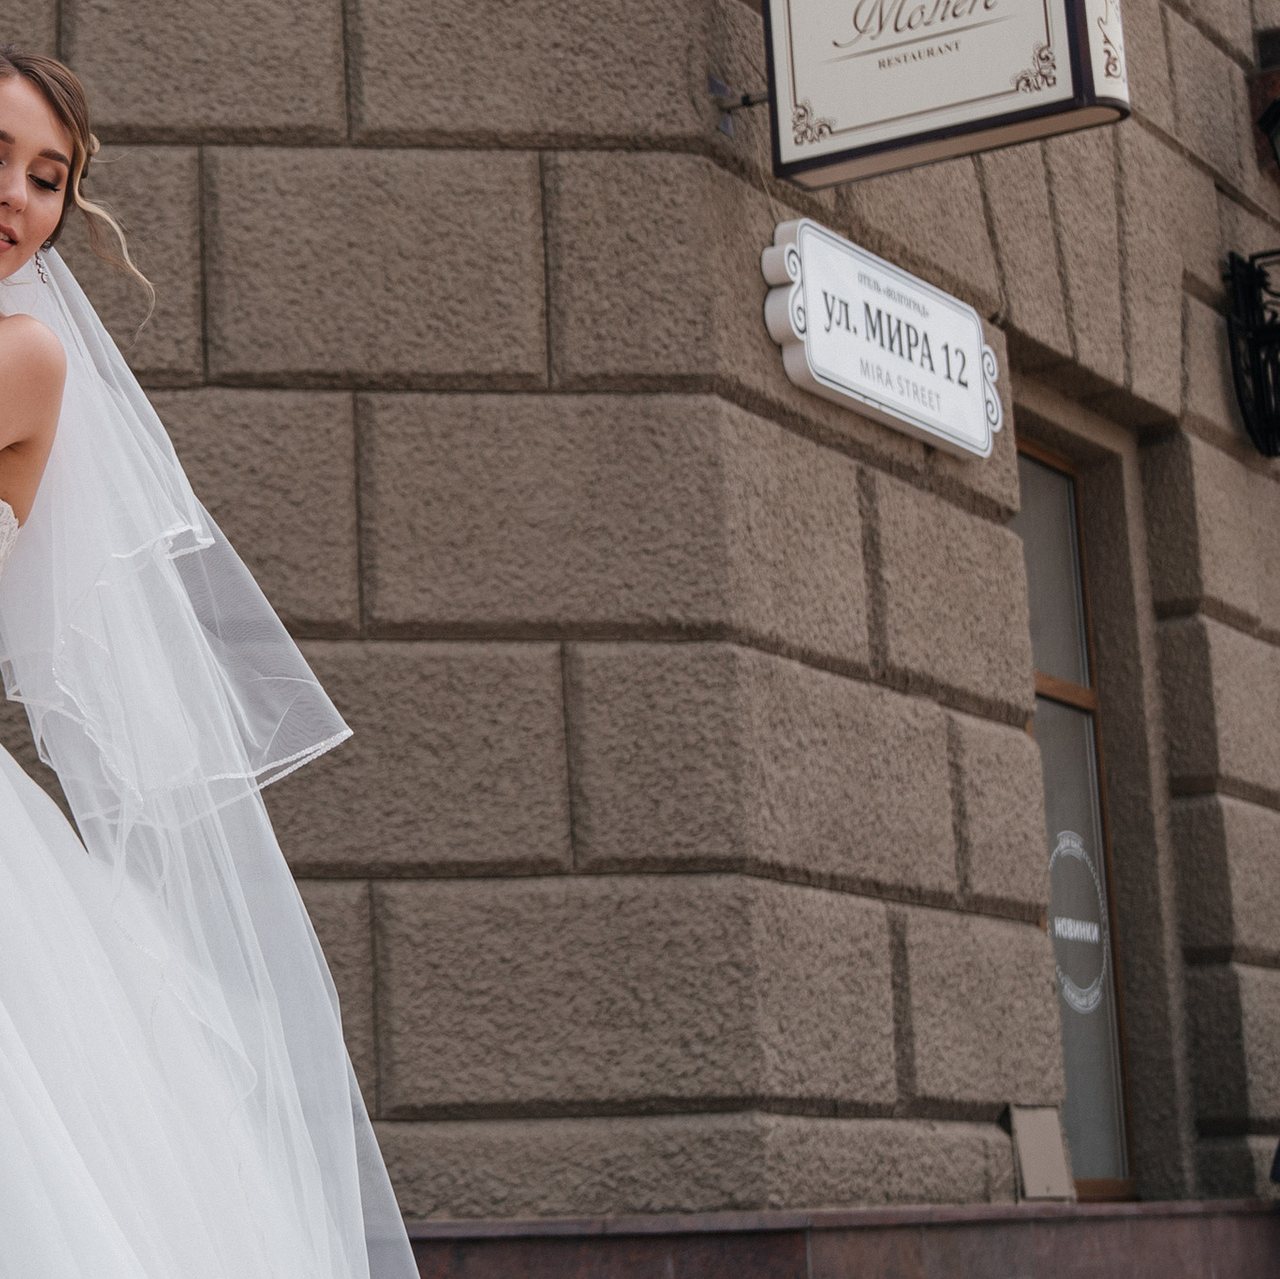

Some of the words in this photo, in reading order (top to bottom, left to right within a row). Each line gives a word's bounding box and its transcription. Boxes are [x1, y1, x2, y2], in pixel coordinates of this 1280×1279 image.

[878, 40, 961, 70] RESTAURANT
[863, 301, 936, 374] МИРА
[941, 341, 969, 389] 12
[859, 357, 894, 391] MIRA
[897, 374, 941, 413] STREET
[1054, 916, 1100, 944] НОВИНКИ
